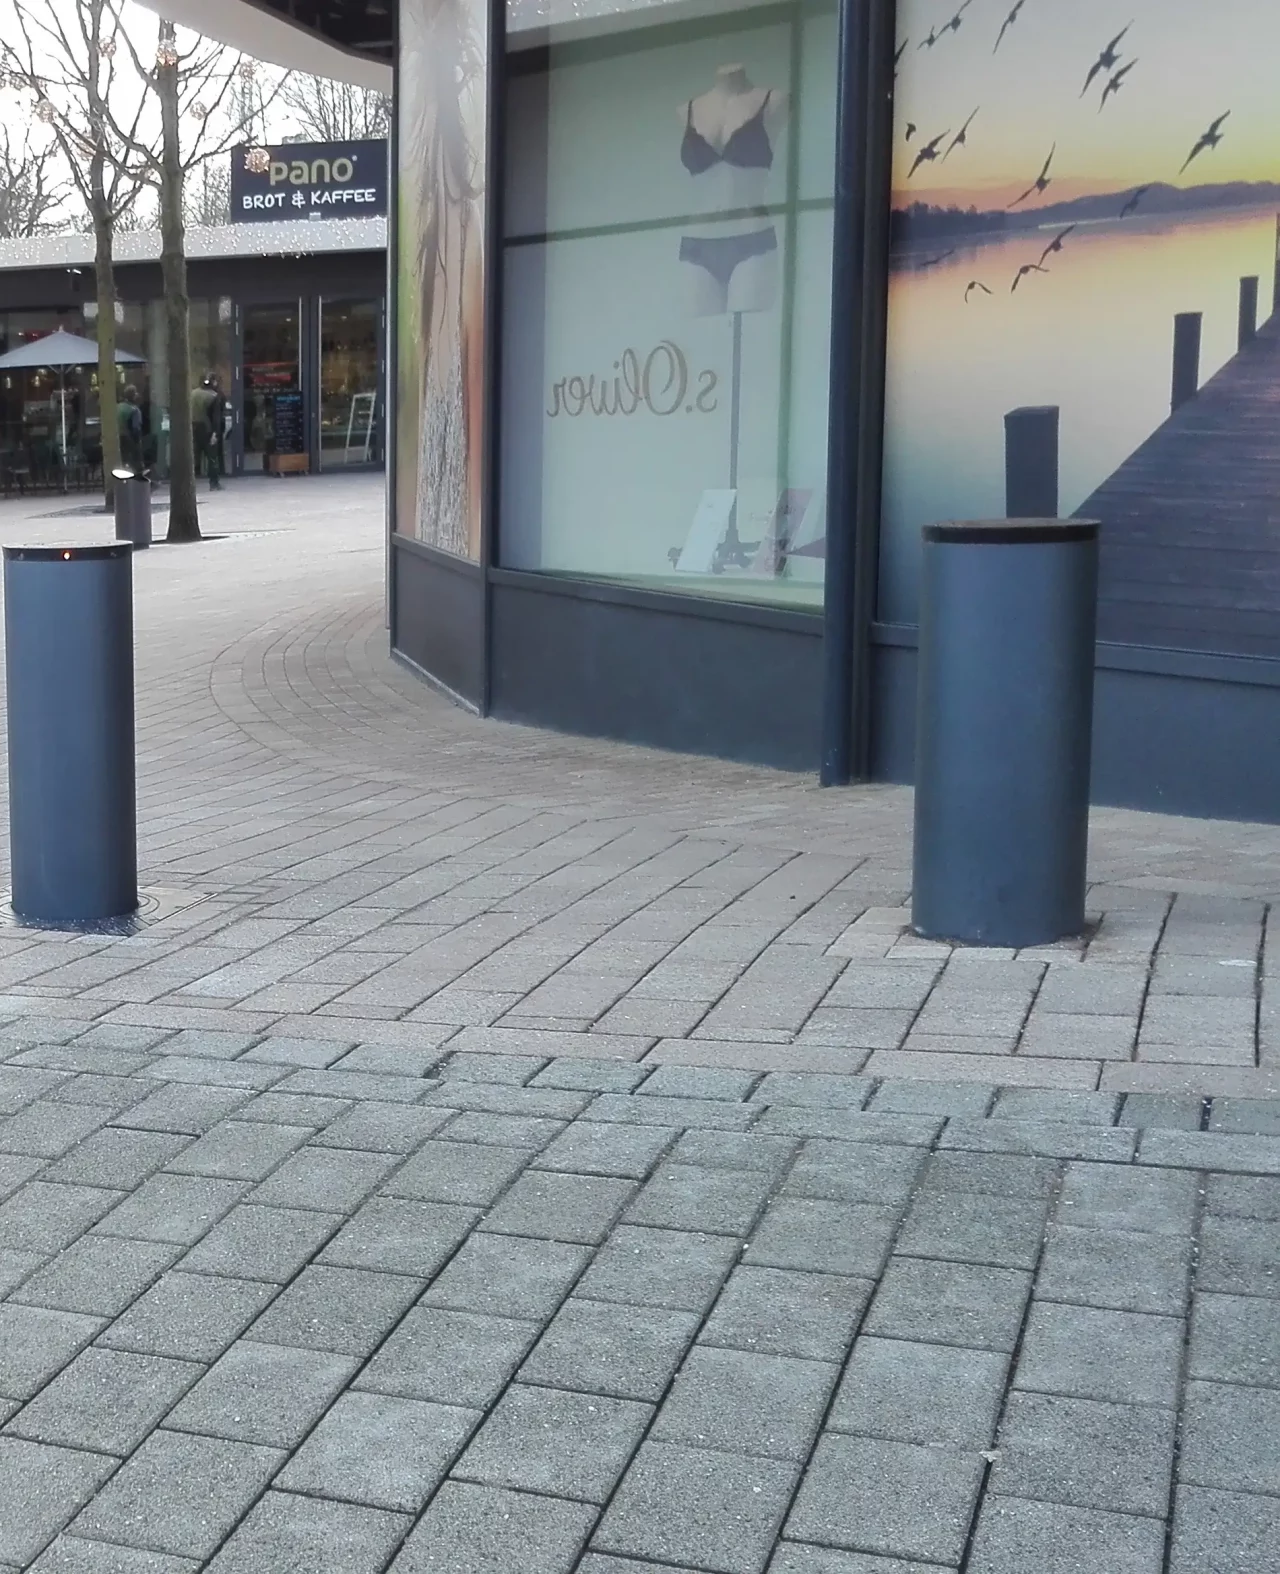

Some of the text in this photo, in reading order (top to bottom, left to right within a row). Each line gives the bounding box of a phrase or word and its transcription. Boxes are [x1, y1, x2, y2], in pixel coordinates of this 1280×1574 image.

[242, 188, 376, 209] BROT & KAFFEE
